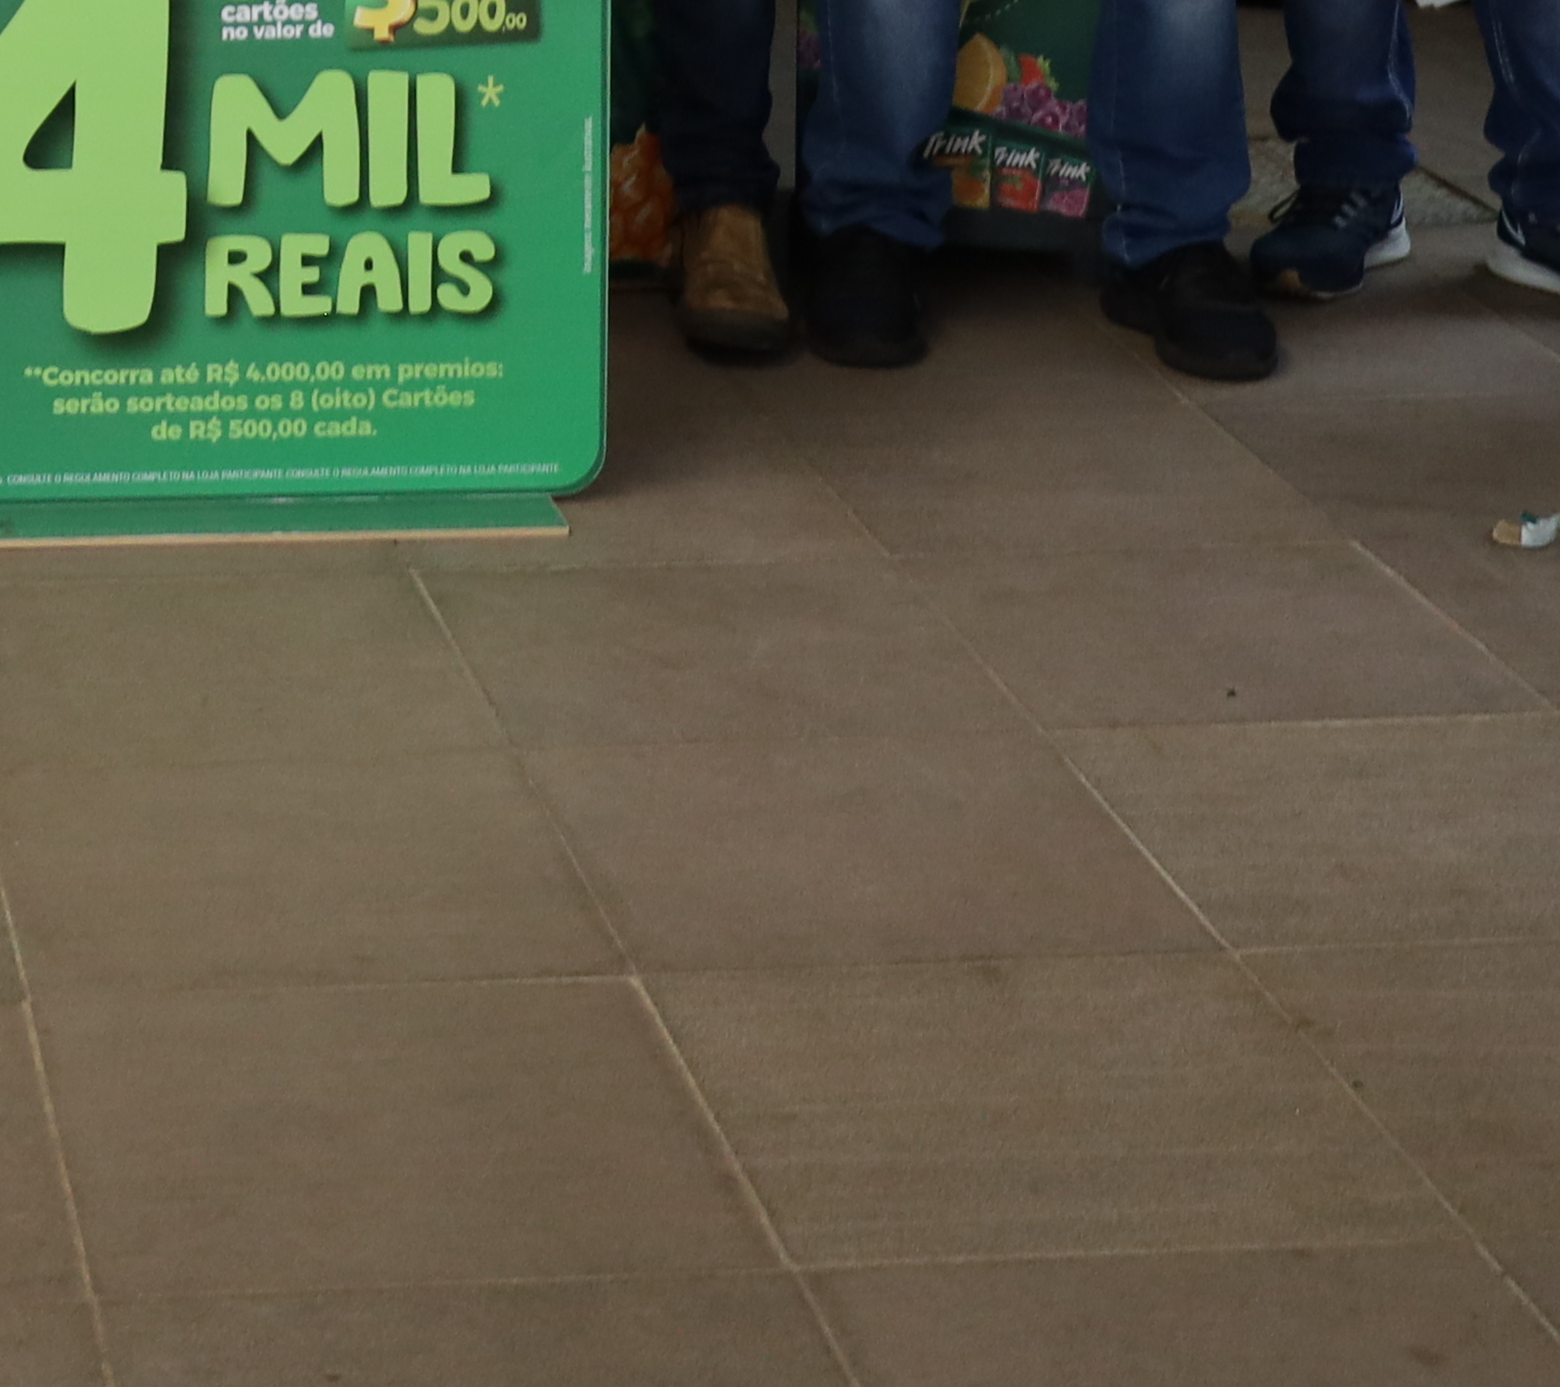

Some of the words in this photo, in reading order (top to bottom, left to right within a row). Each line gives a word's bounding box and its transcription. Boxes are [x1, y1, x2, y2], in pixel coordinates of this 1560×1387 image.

[221, 22, 248, 41] no
[251, 19, 304, 40] valor
[308, 18, 335, 39] de
[203, 230, 497, 319] REAIS
[160, 363, 199, 385] até
[206, 360, 240, 386] R$
[246, 361, 345, 385] 4.000,00
[351, 364, 390, 380] em
[52, 392, 121, 415] serão
[126, 391, 248, 413] sorteados
[254, 394, 281, 411] os
[290, 390, 305, 410] 8
[311, 387, 376, 412] (oito)
[382, 386, 476, 408] Cartões
[151, 419, 182, 441] de
[189, 418, 222, 443] R$
[228, 417, 307, 441] 500,00
[313, 418, 377, 439] cada.
